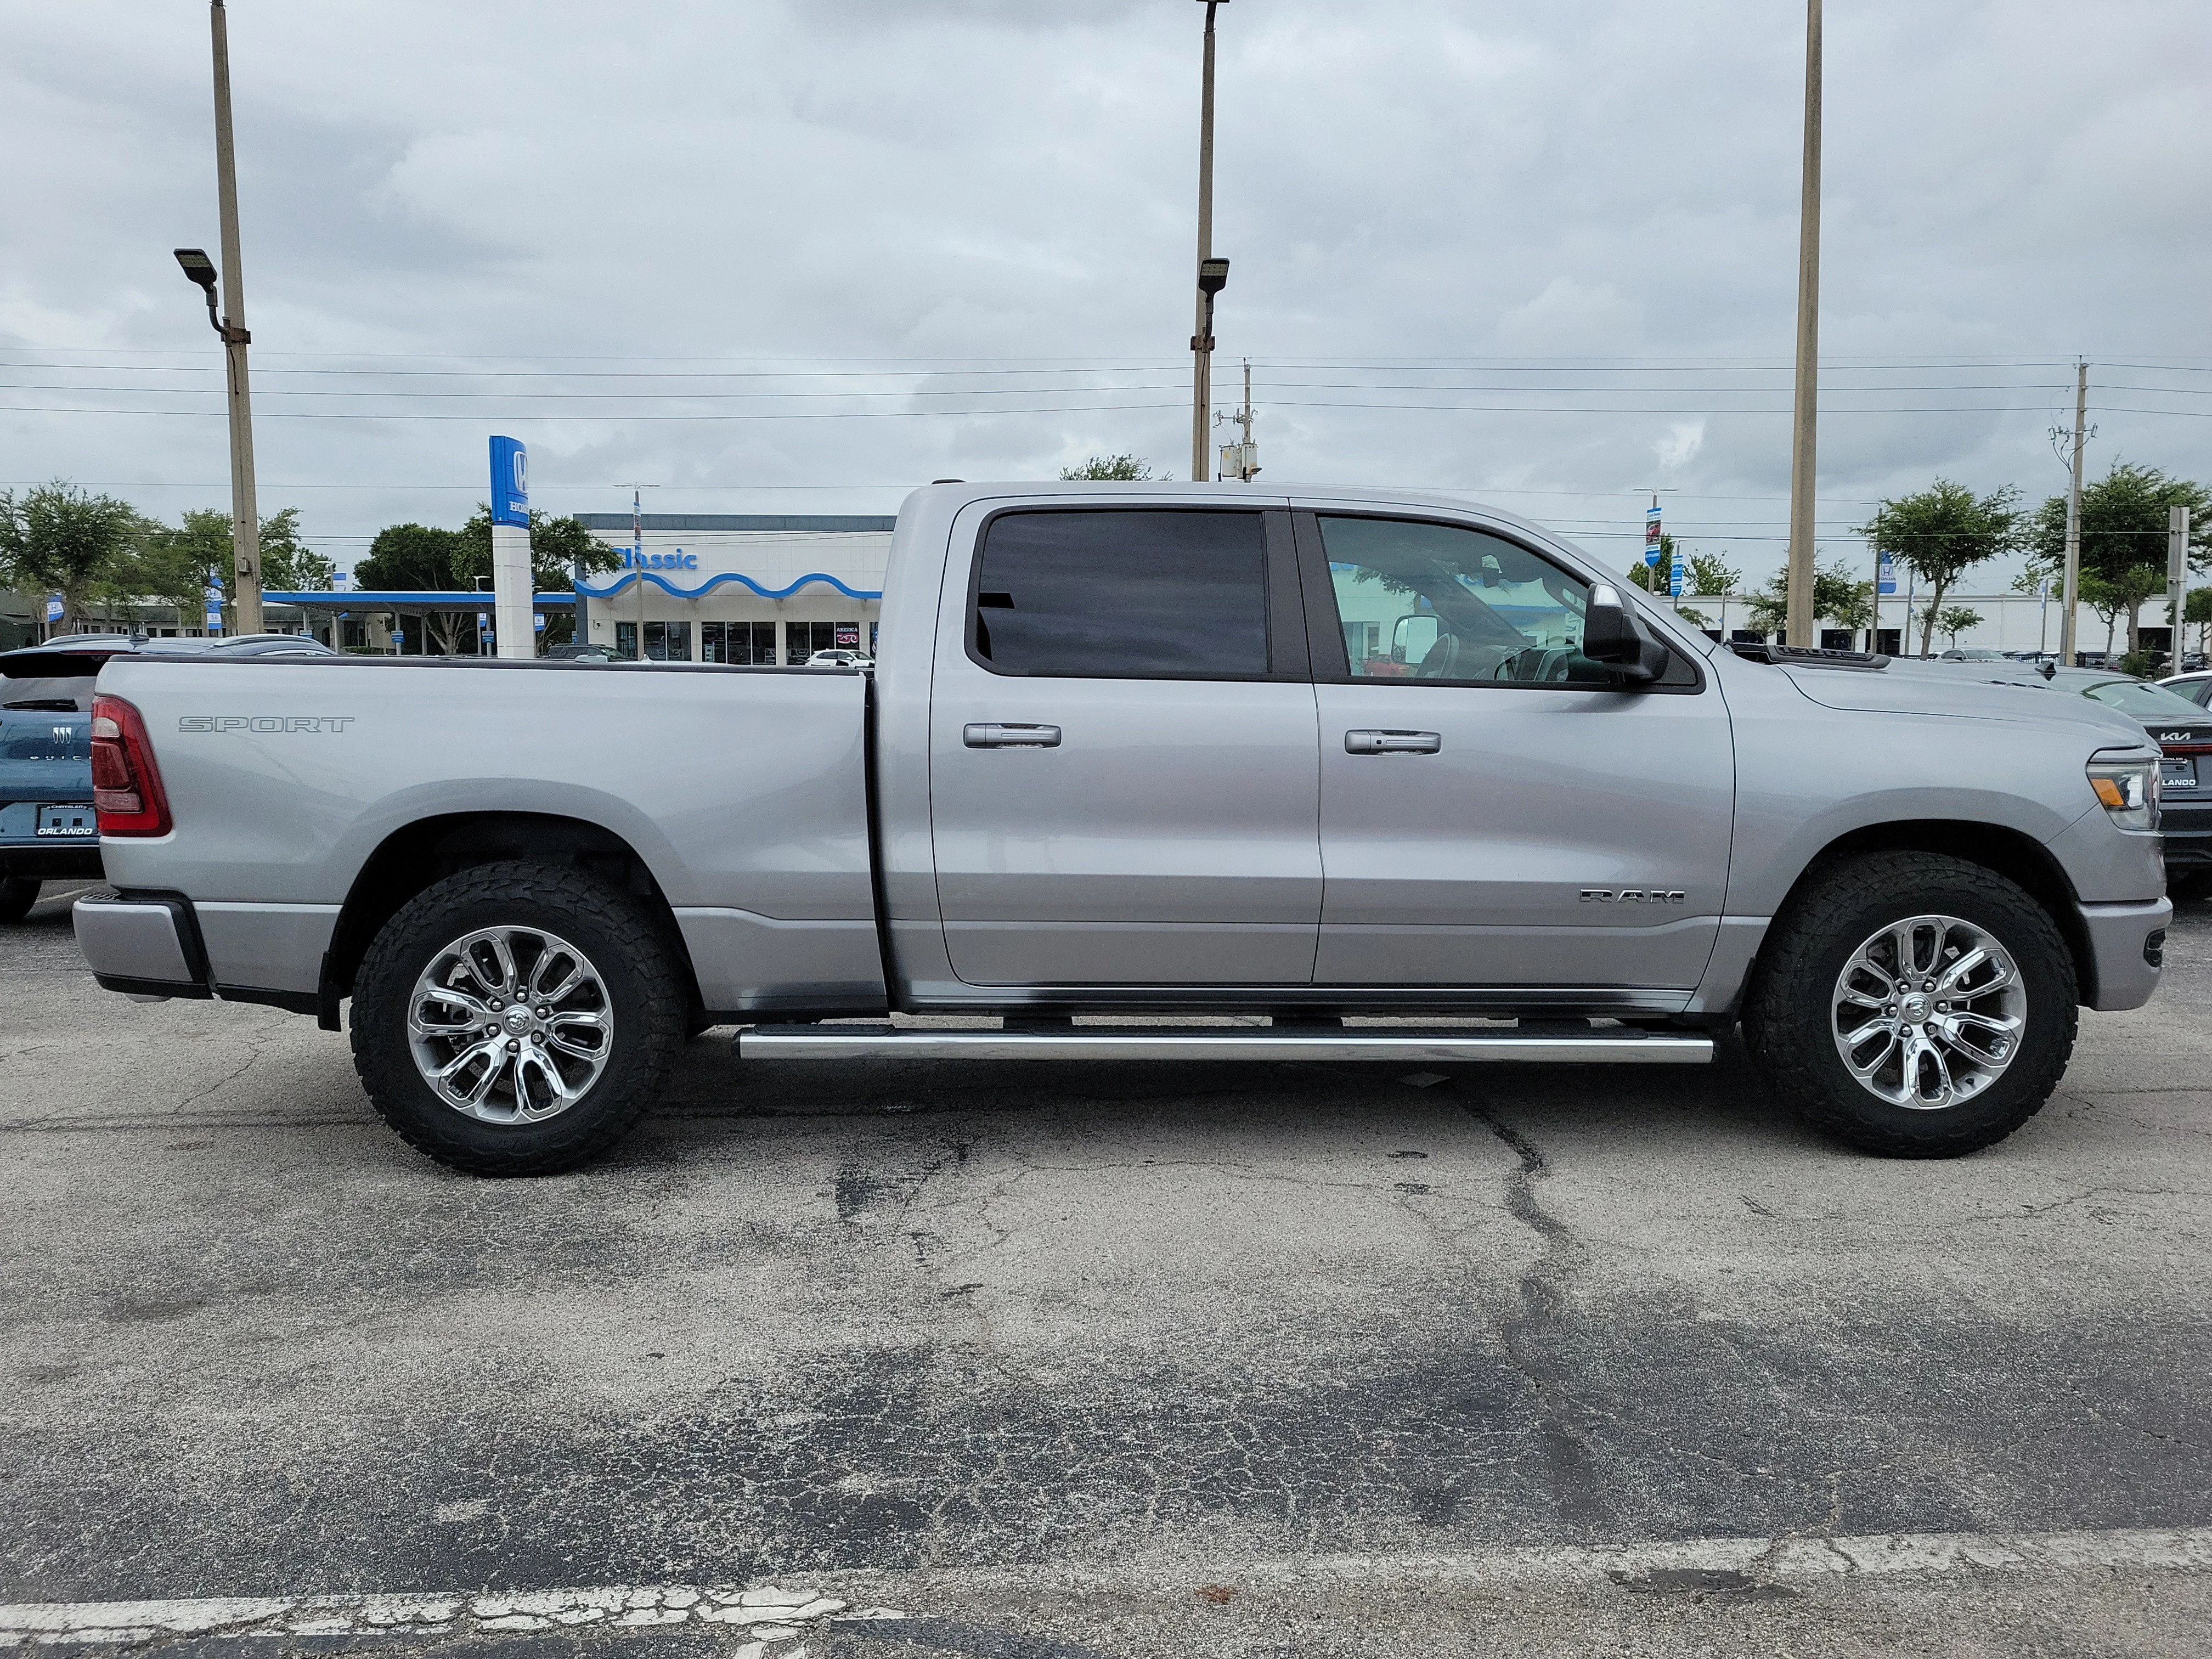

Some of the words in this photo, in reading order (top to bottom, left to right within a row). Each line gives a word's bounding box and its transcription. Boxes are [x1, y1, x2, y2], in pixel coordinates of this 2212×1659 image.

[178, 716, 355, 732] SPORT
[2160, 732, 2191, 741] KIA
[1579, 889, 1685, 904] RAM
